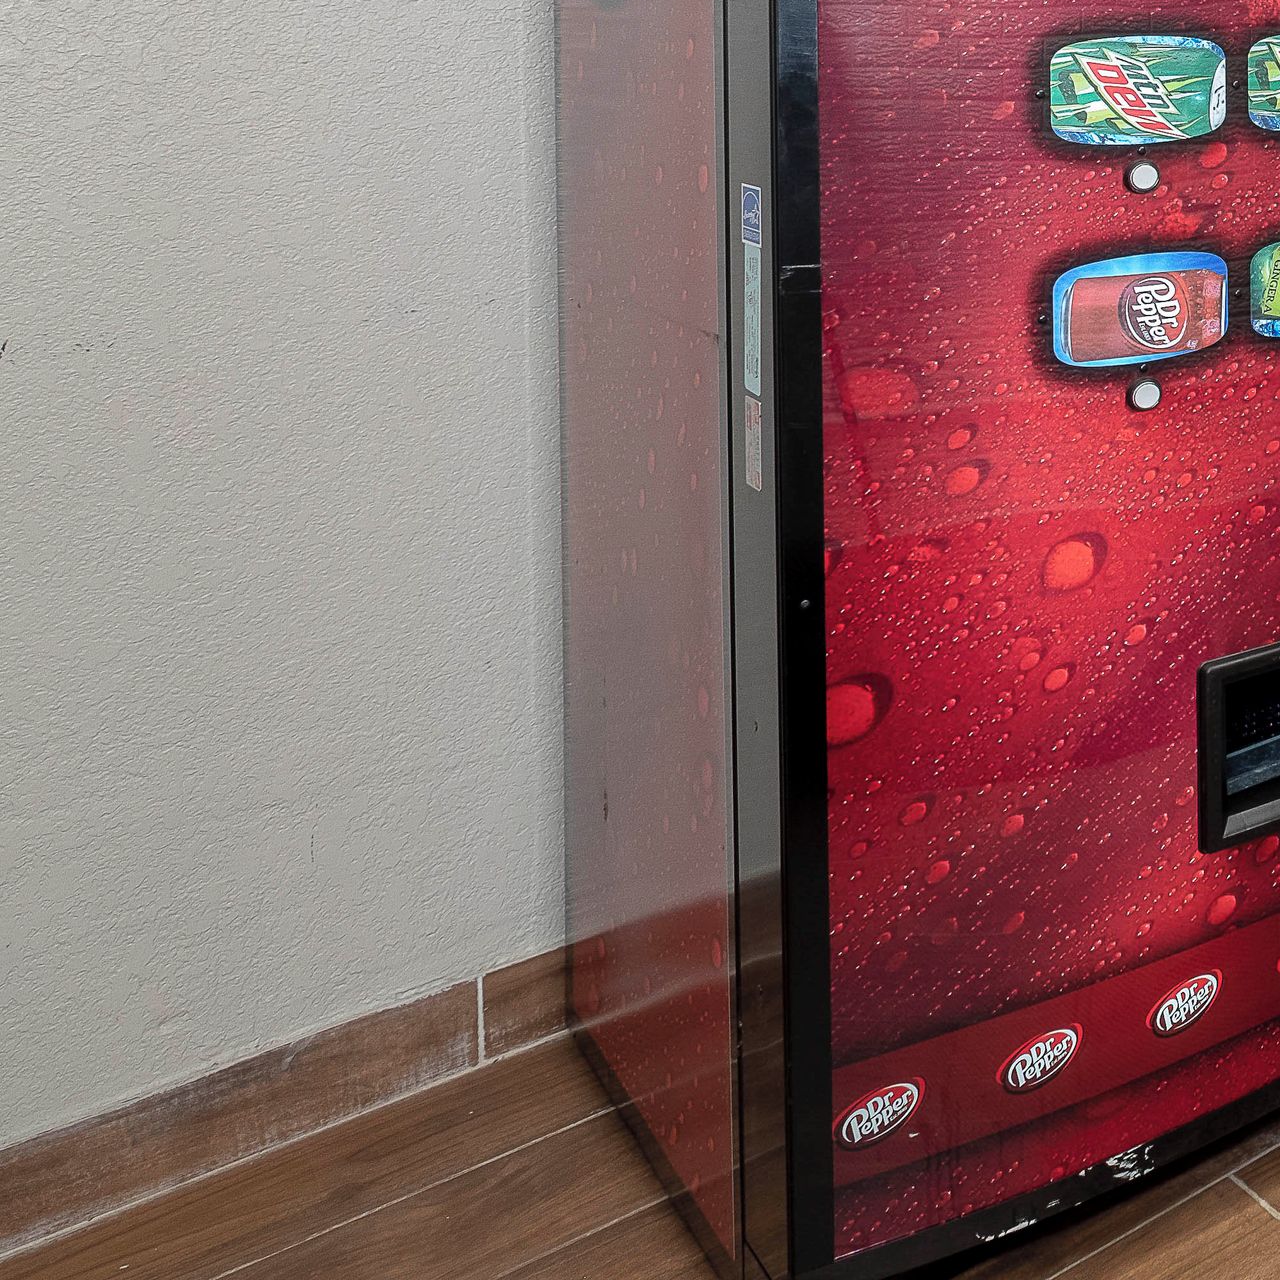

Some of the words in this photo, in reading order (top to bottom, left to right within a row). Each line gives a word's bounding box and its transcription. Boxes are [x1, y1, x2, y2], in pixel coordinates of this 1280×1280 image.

[1131, 277, 1176, 345] Pepper
[1156, 299, 1181, 328] Dr
[1156, 981, 1212, 1032] Pepper
[1176, 982, 1198, 1007] Dr
[1007, 1035, 1071, 1088] Pepper
[1030, 1037, 1054, 1064] Dr
[841, 1090, 912, 1144] Pepper
[866, 1091, 894, 1119] Dr
